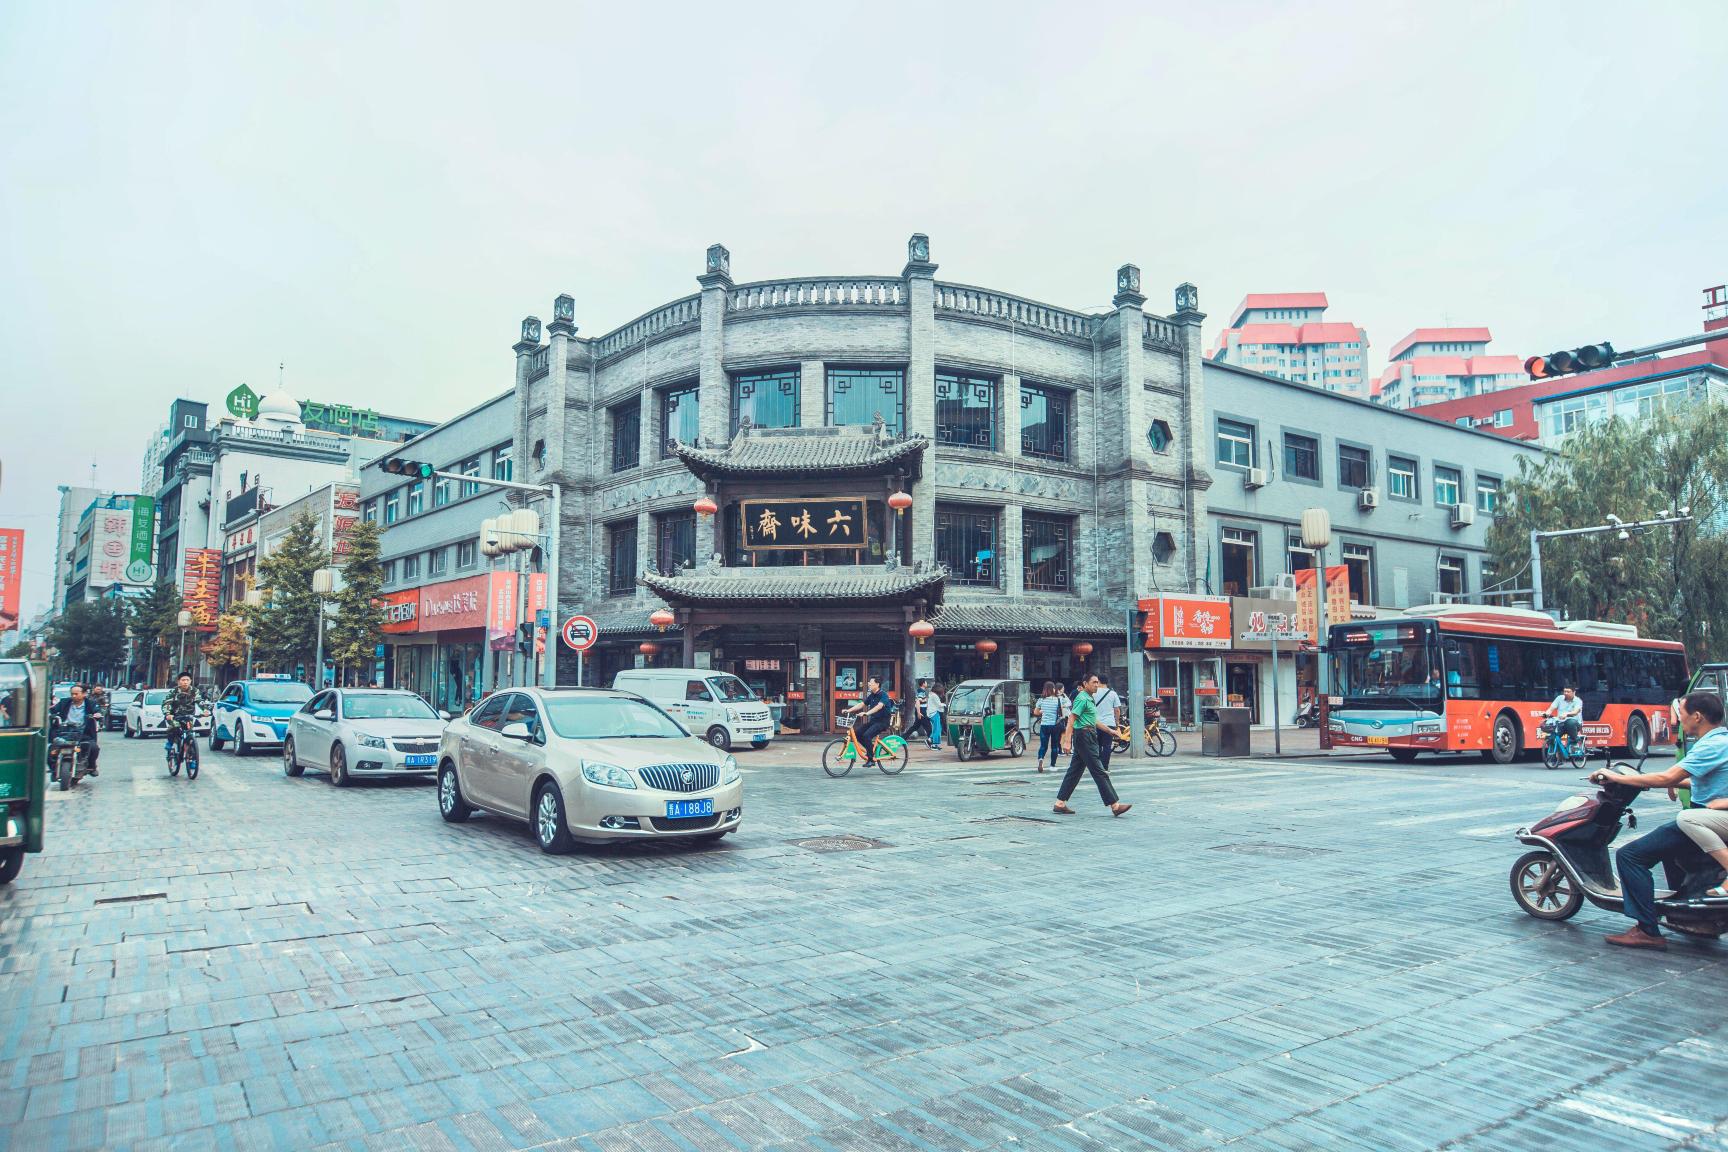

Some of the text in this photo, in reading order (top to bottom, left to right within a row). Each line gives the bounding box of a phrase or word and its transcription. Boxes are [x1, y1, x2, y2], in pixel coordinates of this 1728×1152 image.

[234, 394, 251, 408] Hi
[304, 398, 379, 431] 友酒店
[136, 506, 149, 553] 海友酒店
